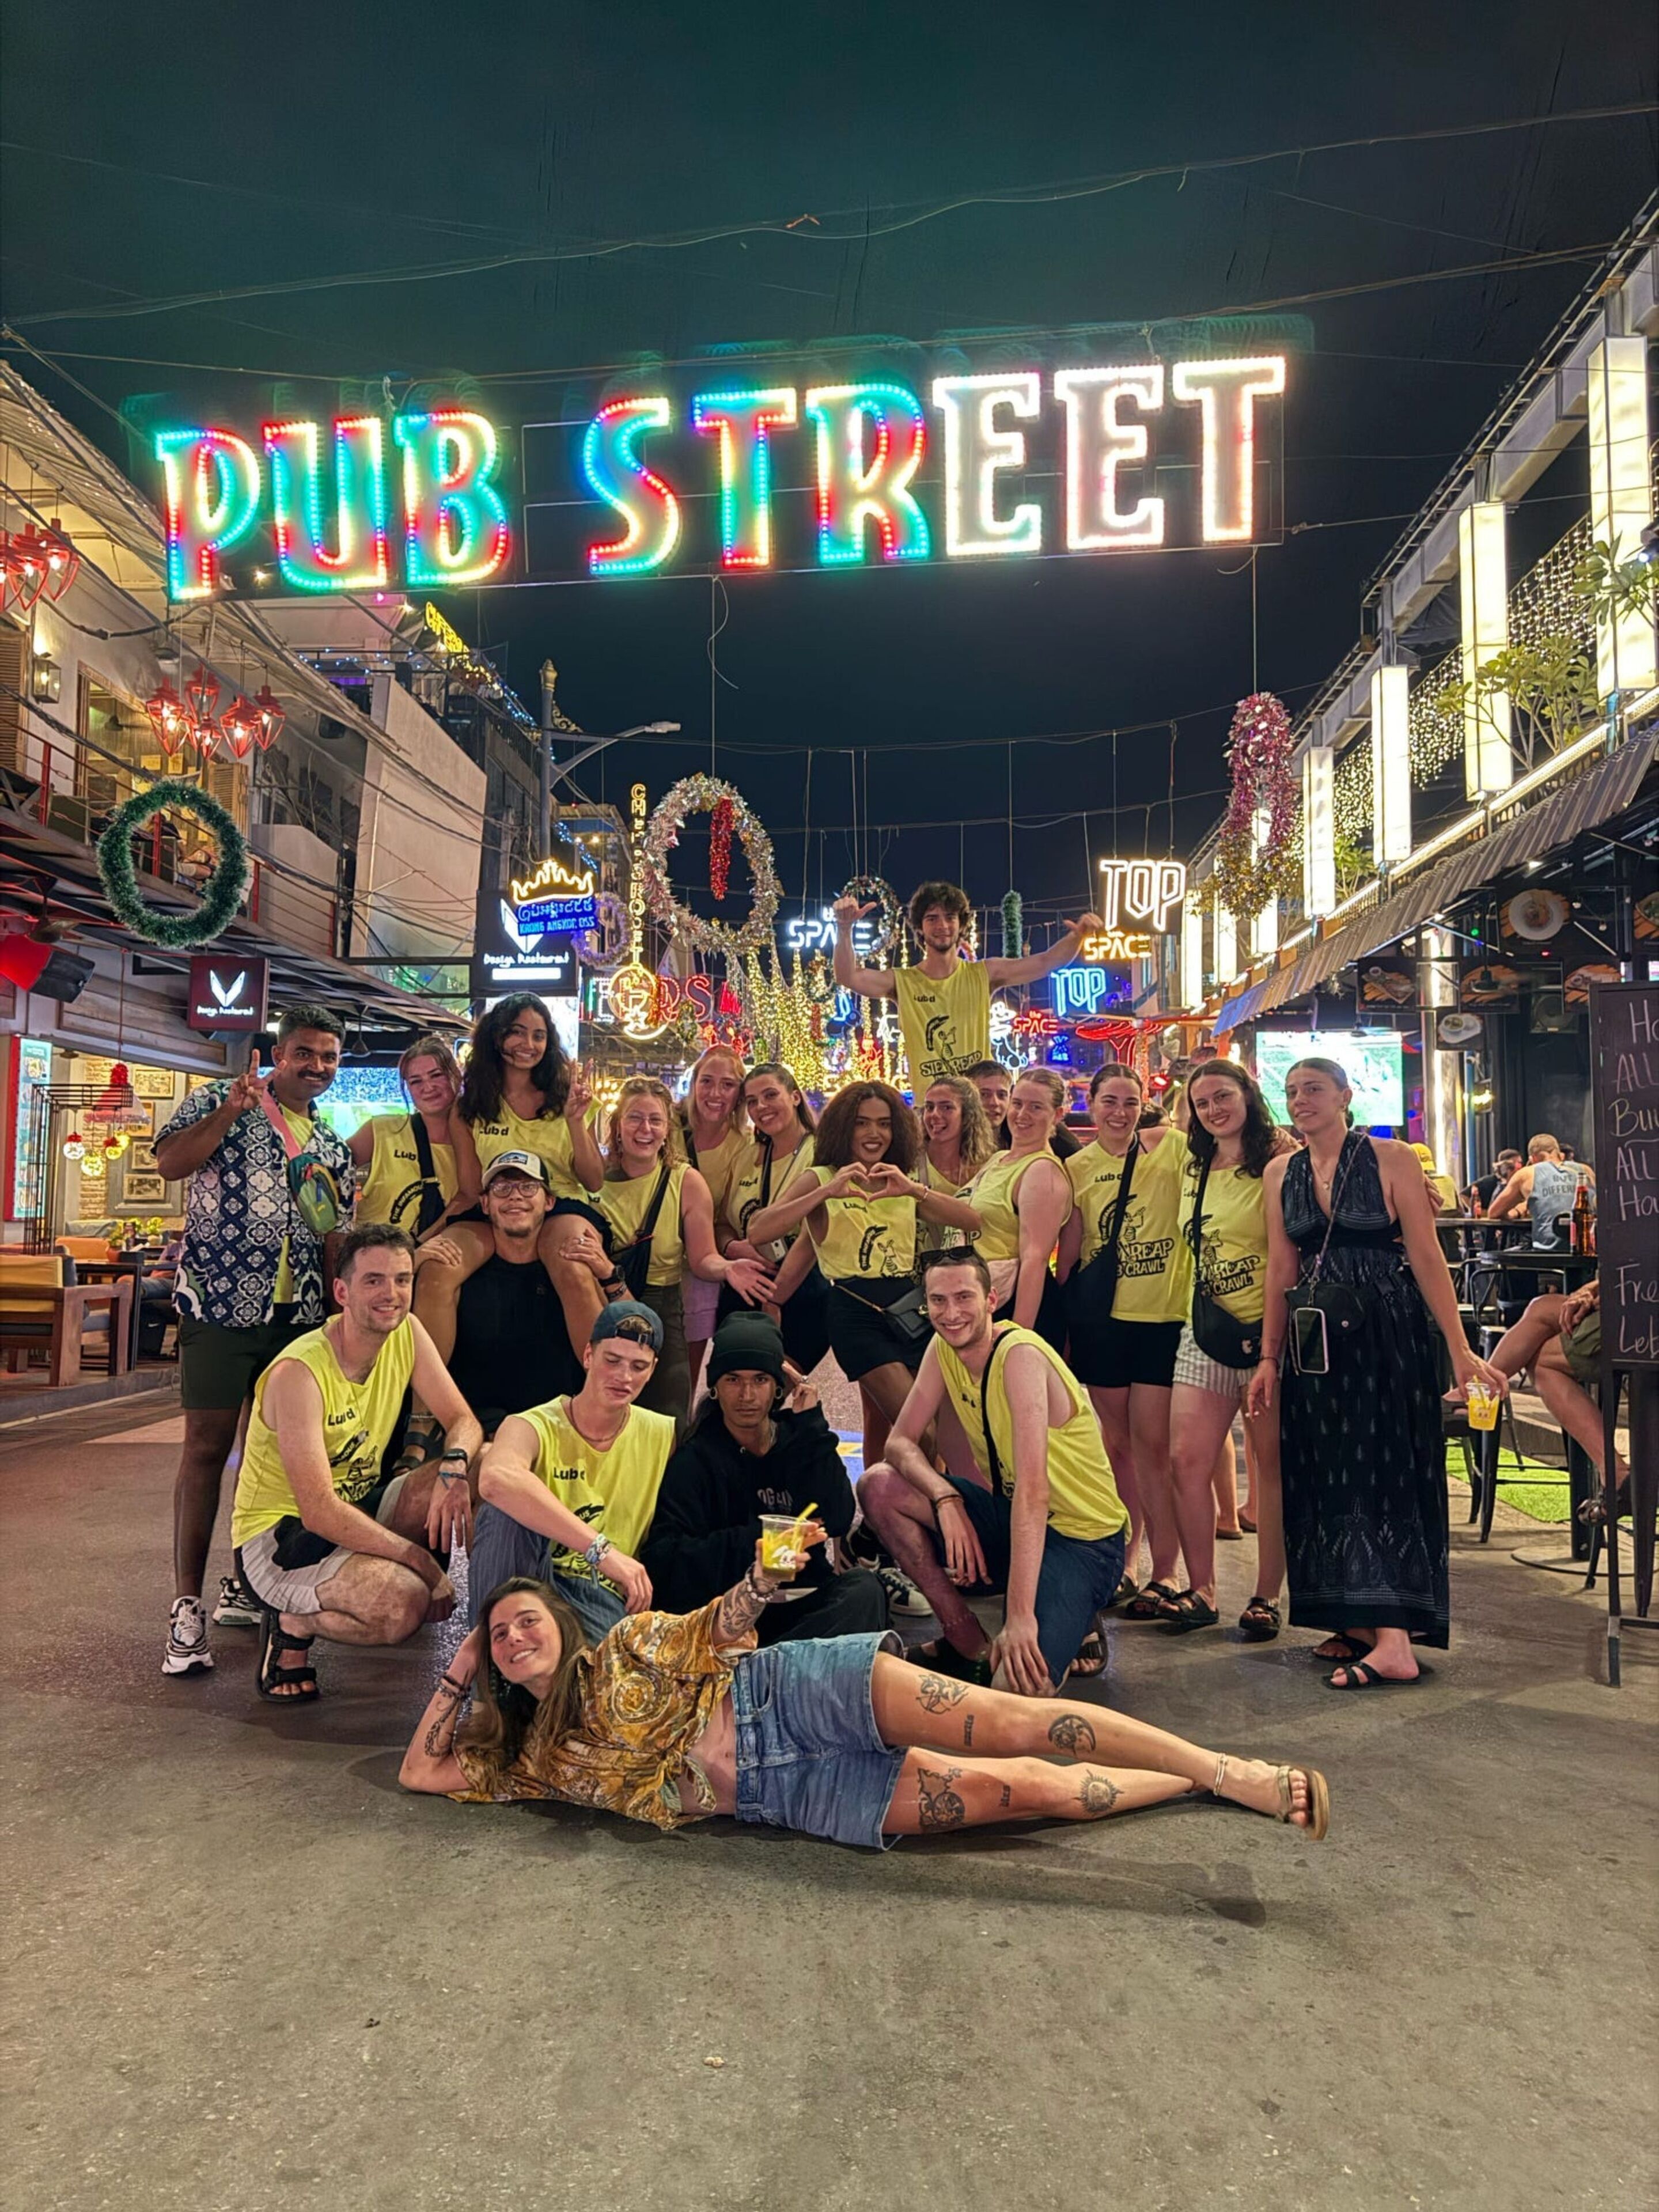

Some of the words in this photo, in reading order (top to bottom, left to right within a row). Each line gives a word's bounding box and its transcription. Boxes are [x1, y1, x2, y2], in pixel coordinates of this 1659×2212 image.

[156, 411, 509, 601] PUB
[584, 355, 1286, 575] STREET
[1100, 859, 1187, 931] TOP
[789, 921, 873, 950] SPAE
[1084, 935, 1152, 960] SPACE
[1051, 968, 1107, 1017] TOP
[1013, 1018, 1058, 1034] SPACE
[1029, 1010, 1041, 1019] the
[1615, 1145, 1657, 1181] ALL
[1126, 1260, 1165, 1276] CRAWL
[1213, 1273, 1253, 1294] CRAWL
